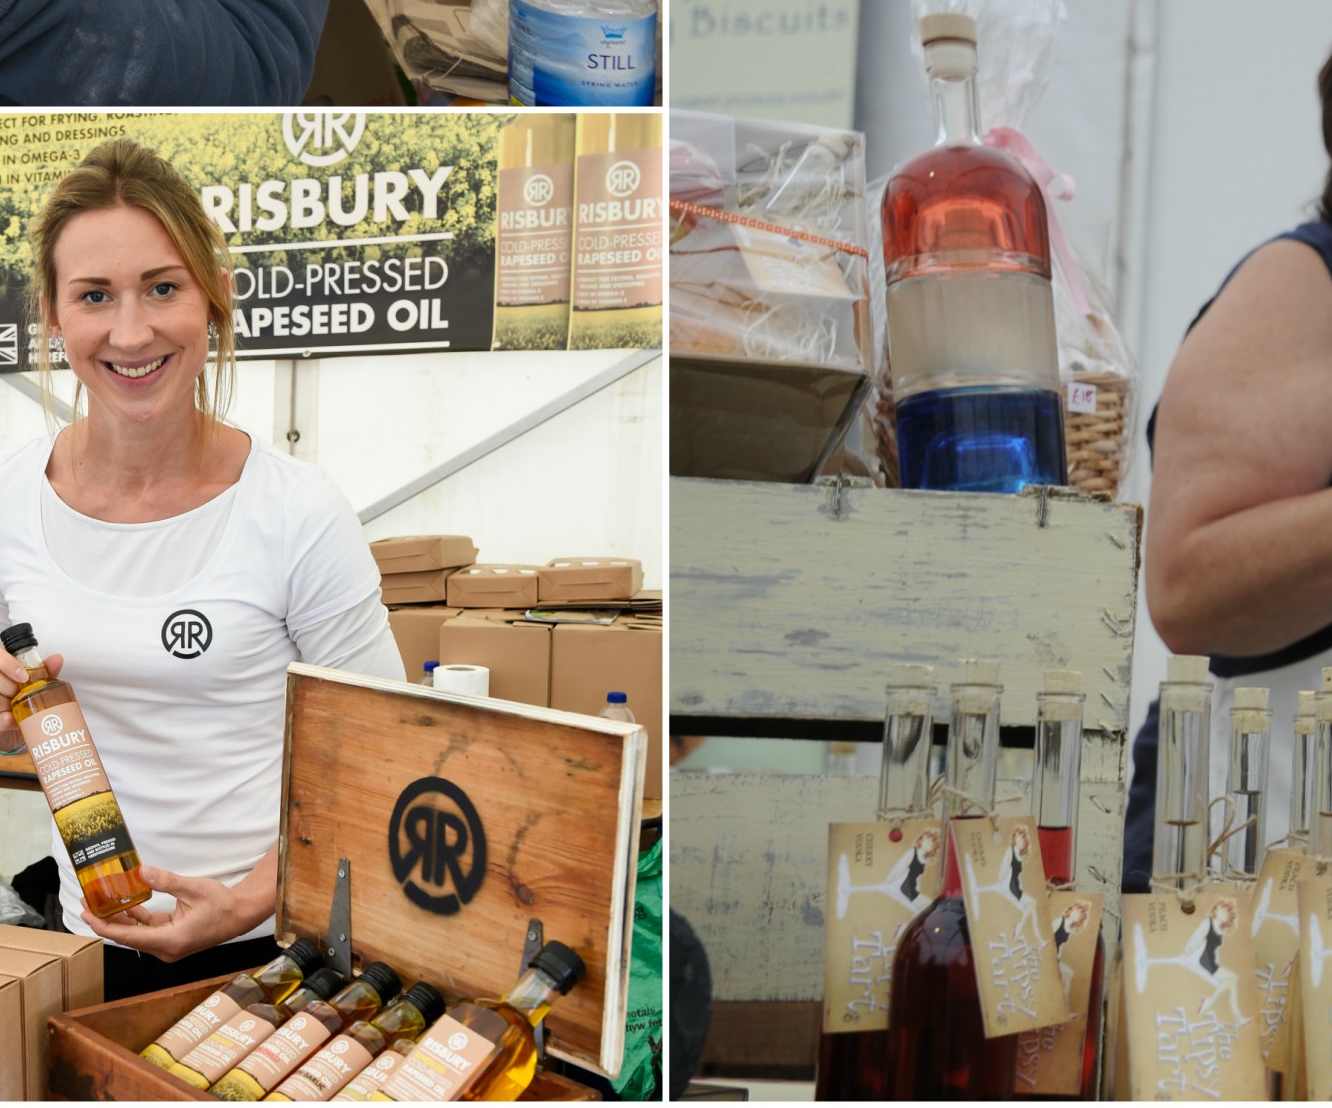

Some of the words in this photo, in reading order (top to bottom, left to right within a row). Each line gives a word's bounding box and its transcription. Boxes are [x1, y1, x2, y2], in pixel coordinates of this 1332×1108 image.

[691, 4, 850, 39] Biscuits
[587, 54, 636, 70] STILL
[21, 115, 46, 128] FOR
[50, 113, 101, 125] FRYING,
[23, 132, 51, 144] AND
[55, 125, 126, 141] DRESSINGS
[2, 154, 16, 166] IN
[21, 149, 80, 164] OMEGA-3
[6, 174, 20, 185] IN
[201, 165, 454, 233] RISBURY
[232, 256, 449, 300] OLD-PRESSED
[387, 298, 449, 331] OIL
[31, 729, 86, 760] RISBURY
[39, 748, 94, 775] COLD-PRESSED
[42, 761, 83, 785] RAPESEED
[84, 756, 97, 768] OIL
